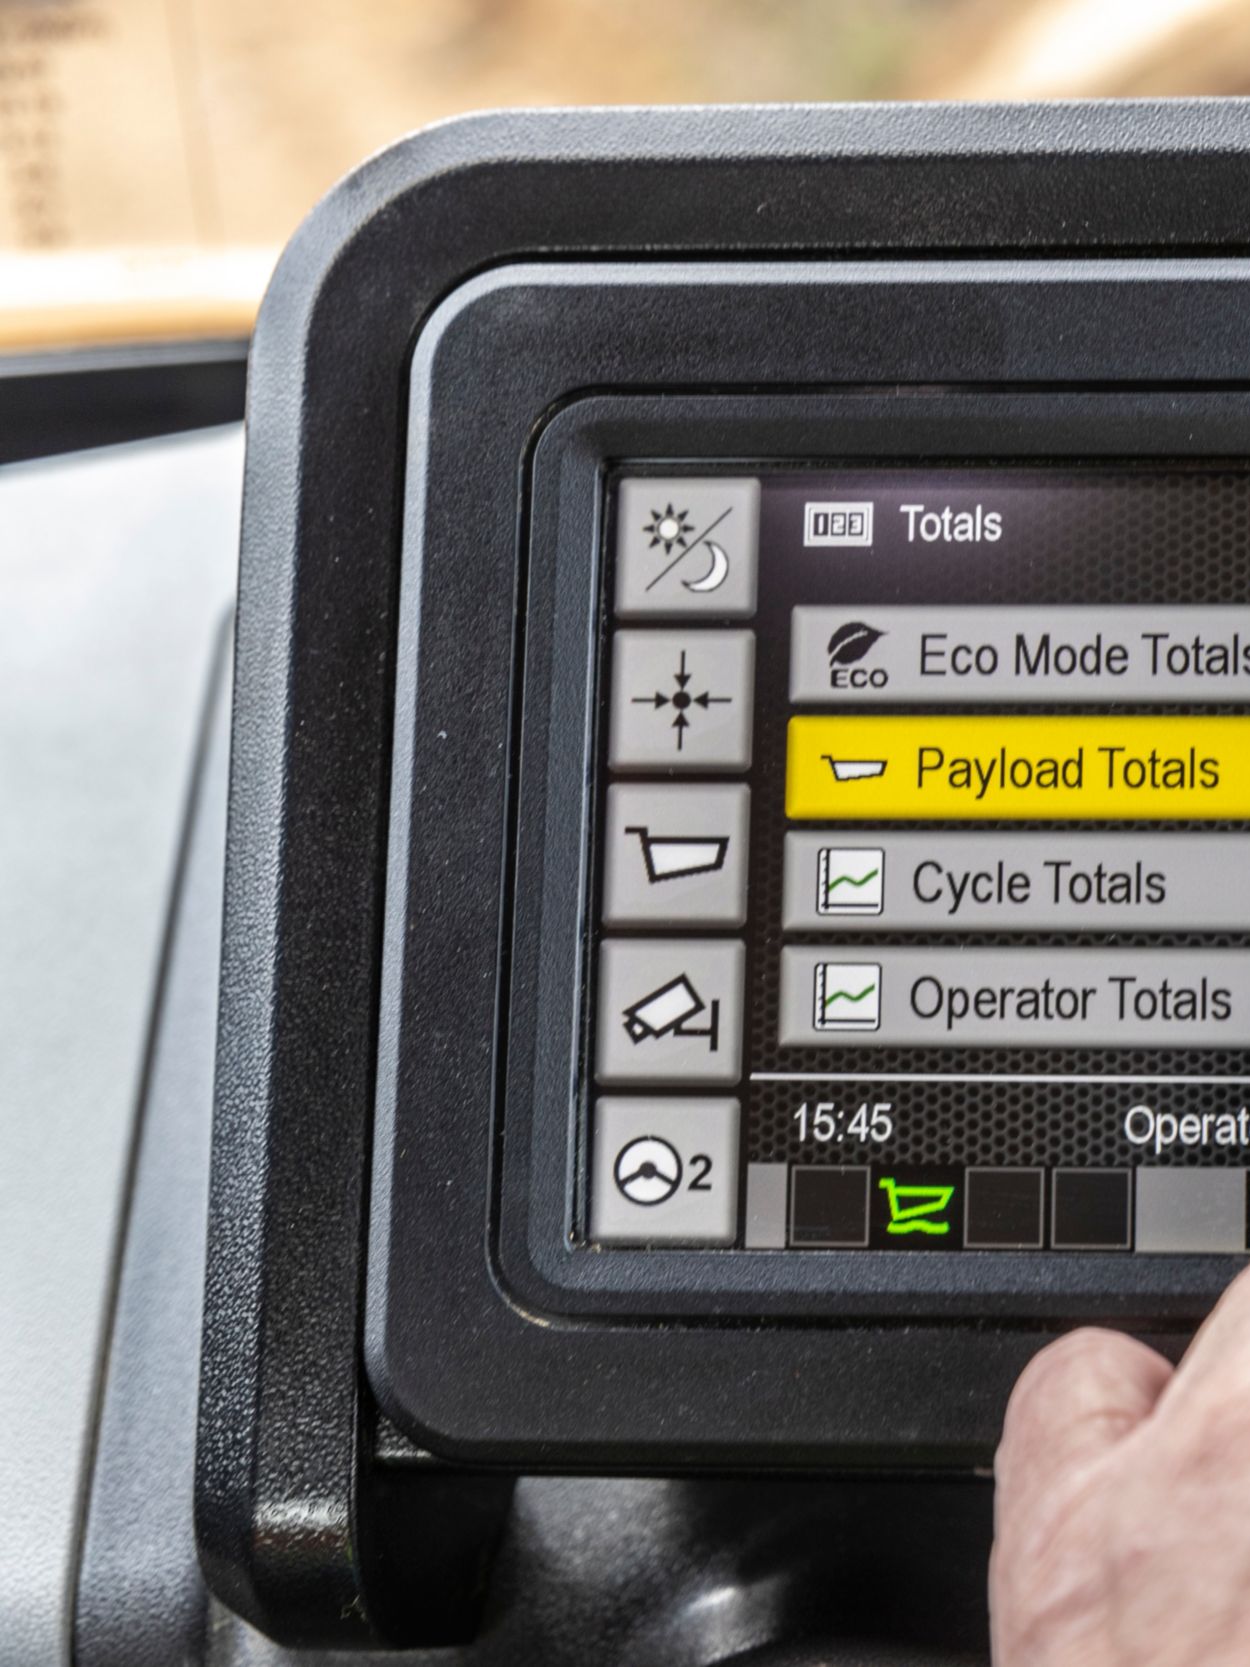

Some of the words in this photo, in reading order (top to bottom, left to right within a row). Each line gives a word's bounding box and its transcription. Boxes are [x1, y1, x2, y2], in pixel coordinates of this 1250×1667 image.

[899, 504, 1002, 542] Totals
[921, 633, 999, 676] Eco
[1014, 633, 1129, 676] Mode
[830, 668, 889, 689] ECO
[917, 746, 1084, 800] Payload
[1097, 747, 1220, 790] Totals
[913, 860, 1031, 915] Cycle
[1043, 860, 1166, 905] Totals
[910, 975, 1097, 1031] Operator
[1108, 976, 1232, 1021] Totals
[794, 1102, 893, 1142] 15:45
[687, 1153, 713, 1191] 2
